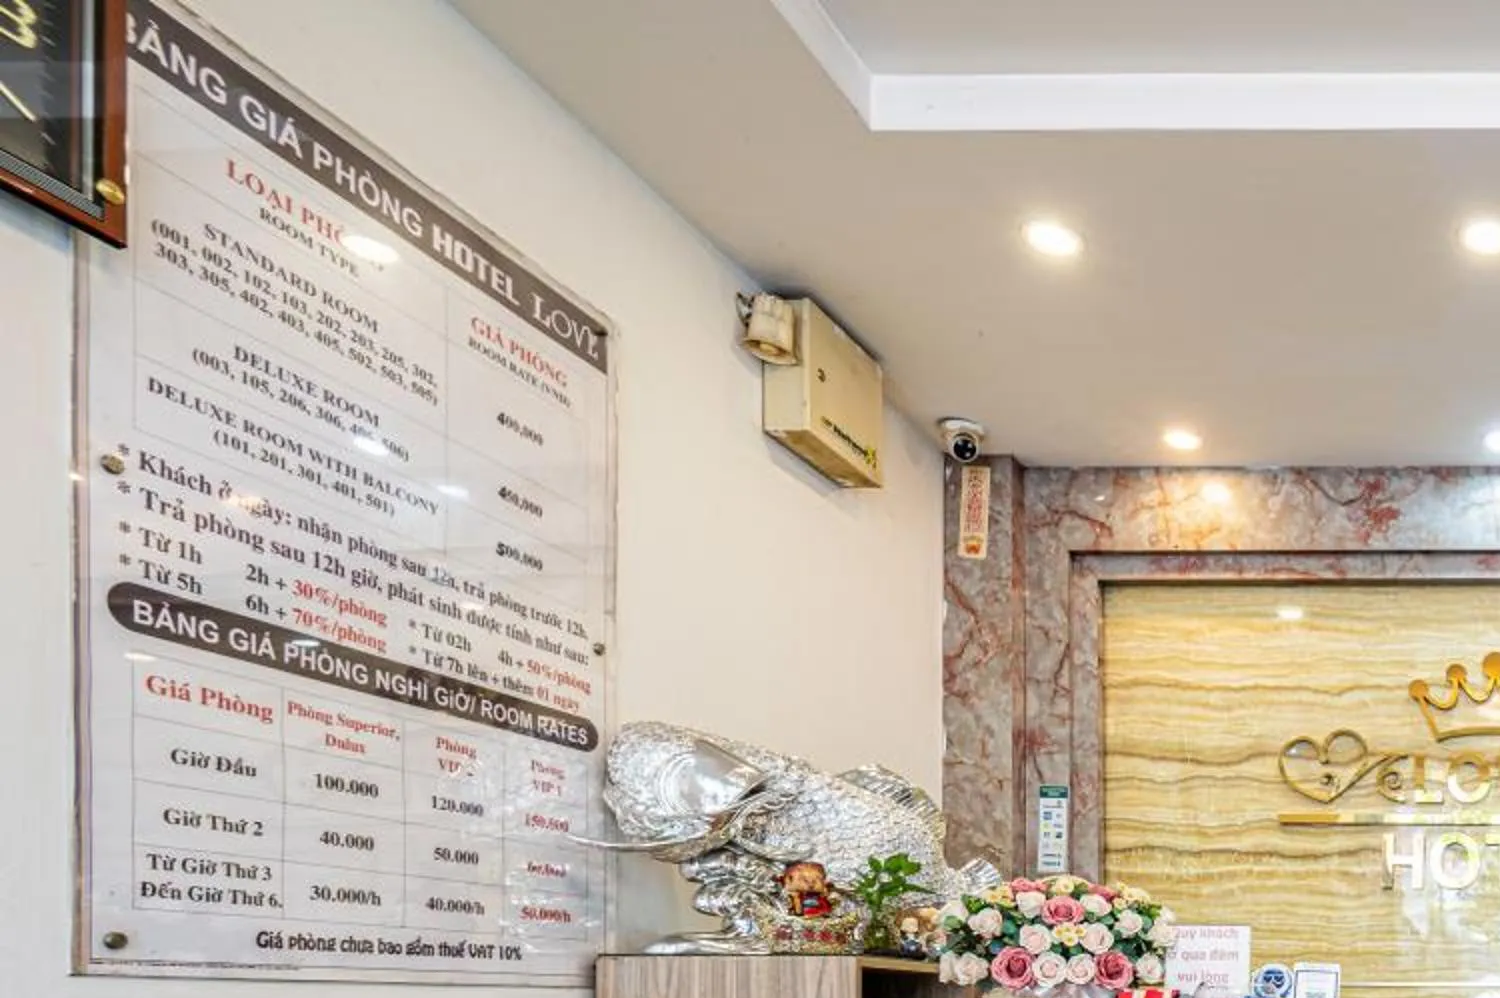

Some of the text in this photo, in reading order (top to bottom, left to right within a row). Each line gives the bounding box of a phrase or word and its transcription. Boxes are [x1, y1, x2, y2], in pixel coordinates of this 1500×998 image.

[226, 159, 293, 215] LOẠI
[240, 95, 303, 159] GIÁ
[313, 141, 422, 238] PHÒNG
[432, 224, 520, 305] HOTEL
[530, 291, 599, 360] LOVE
[259, 206, 313, 249] ROOM
[318, 244, 360, 277] TYPE
[204, 223, 318, 297] STANDARD
[322, 290, 379, 333] ROOM
[233, 345, 380, 428] DELUXE ROOM
[147, 376, 439, 516] DELUXE ROOM WITH BALCONY
[138, 451, 212, 496] Khách
[298, 515, 343, 546] nhận
[348, 535, 398, 569] phòng
[401, 557, 426, 577] sau
[463, 582, 485, 601] trả
[138, 486, 186, 523] Trả
[193, 511, 265, 555] phòng
[270, 541, 306, 564] sau
[312, 550, 346, 579] 12h
[387, 581, 424, 607] phát
[429, 596, 462, 620] sinh
[138, 527, 172, 554] Từ
[178, 541, 202, 565] 1h
[245, 563, 269, 586] 2h
[138, 559, 172, 586] Từ
[177, 572, 202, 595] 5h
[245, 594, 269, 616] 6h
[421, 623, 444, 642] Từ
[446, 634, 472, 653] 02h
[497, 650, 513, 666] 4h
[447, 656, 464, 676] 7h
[132, 599, 220, 644] BẢNG
[228, 627, 276, 661] GIÁ
[283, 641, 370, 685] PHÒNG
[480, 699, 533, 729] ROOM
[537, 715, 588, 745] RATES
[144, 674, 274, 725] Giá Phòng
[287, 700, 333, 726] Phòng
[170, 748, 258, 778] Giờ Đầu
[313, 773, 380, 799] 100.000
[431, 795, 484, 817] 120.000
[162, 808, 264, 837] Giờ Thứ 2
[319, 831, 375, 851] 40.000
[146, 853, 272, 881] Từ Giờ Thứ 3
[433, 847, 480, 866] 50.000
[140, 880, 182, 901] Đến
[187, 885, 223, 904] Giờ
[228, 889, 266, 909] Thứ
[309, 885, 383, 907] 30.000/h
[256, 930, 284, 950] Giá
[288, 932, 338, 953] phòng
[377, 938, 402, 956] bao
[468, 943, 495, 959] VAT
[499, 945, 523, 961] 10%
